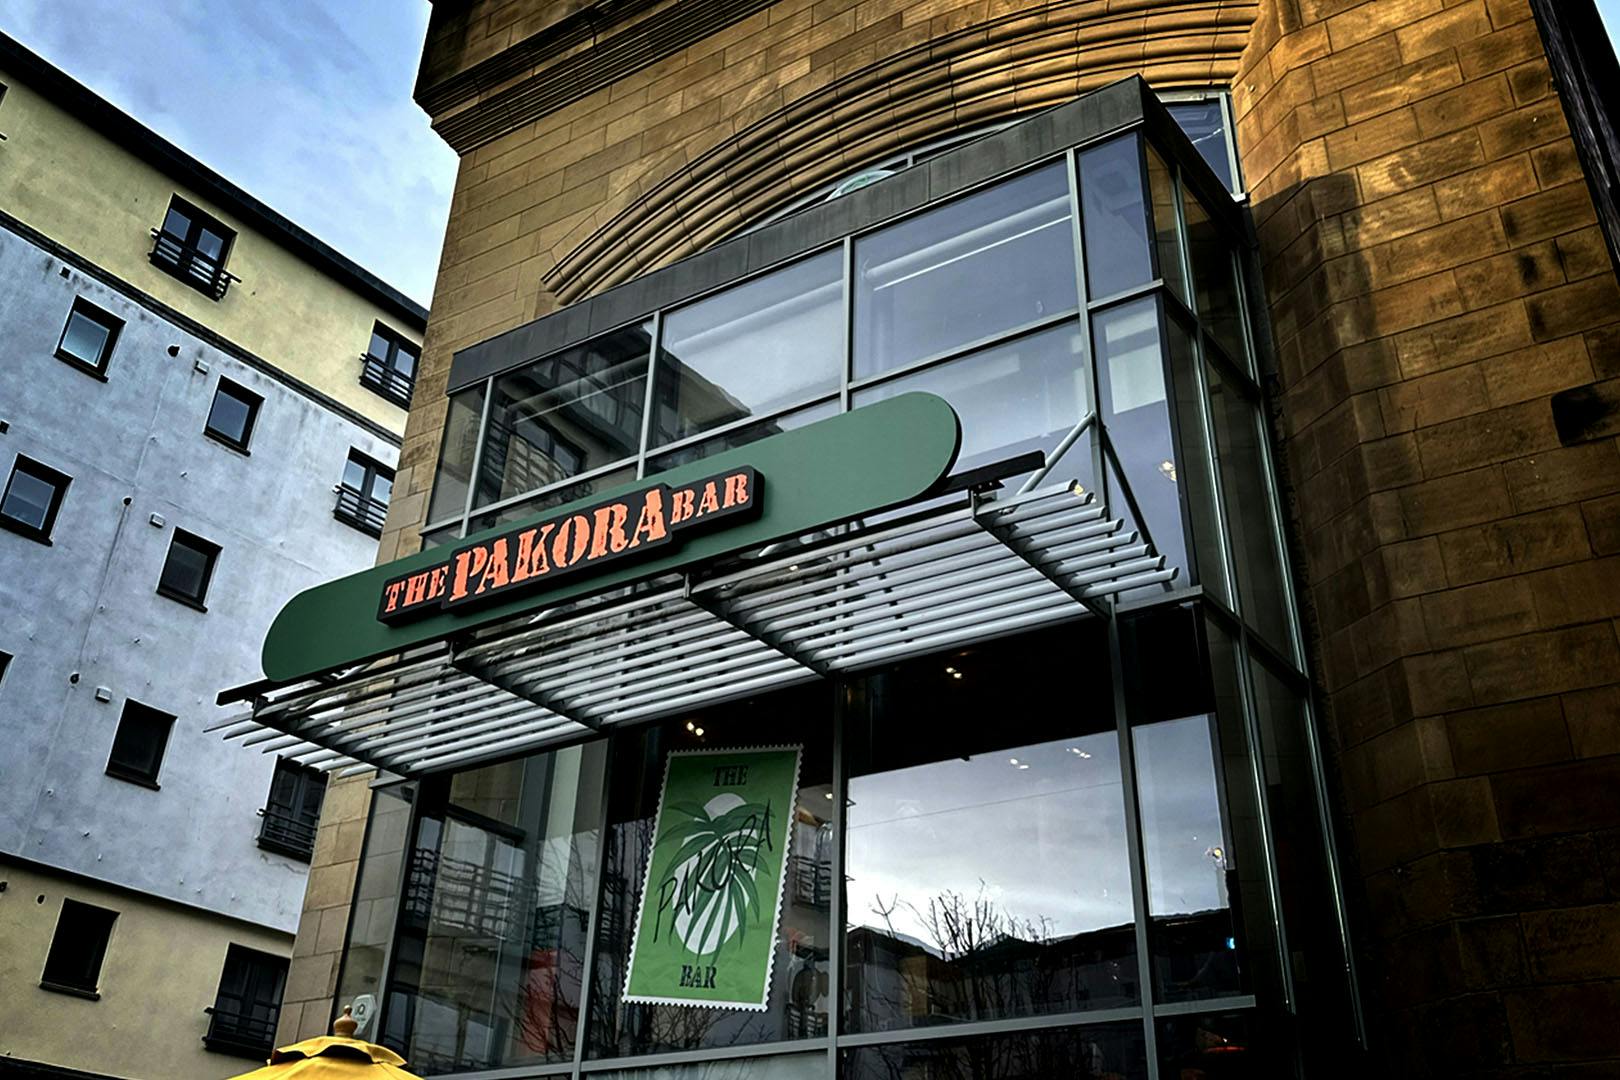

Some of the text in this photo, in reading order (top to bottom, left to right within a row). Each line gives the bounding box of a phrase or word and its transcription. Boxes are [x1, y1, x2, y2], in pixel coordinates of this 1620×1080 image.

[385, 473, 749, 613] THE PAKORA BAR
[713, 766, 748, 787] THE
[653, 798, 773, 943] PAKORA
[680, 964, 718, 989] BAR
